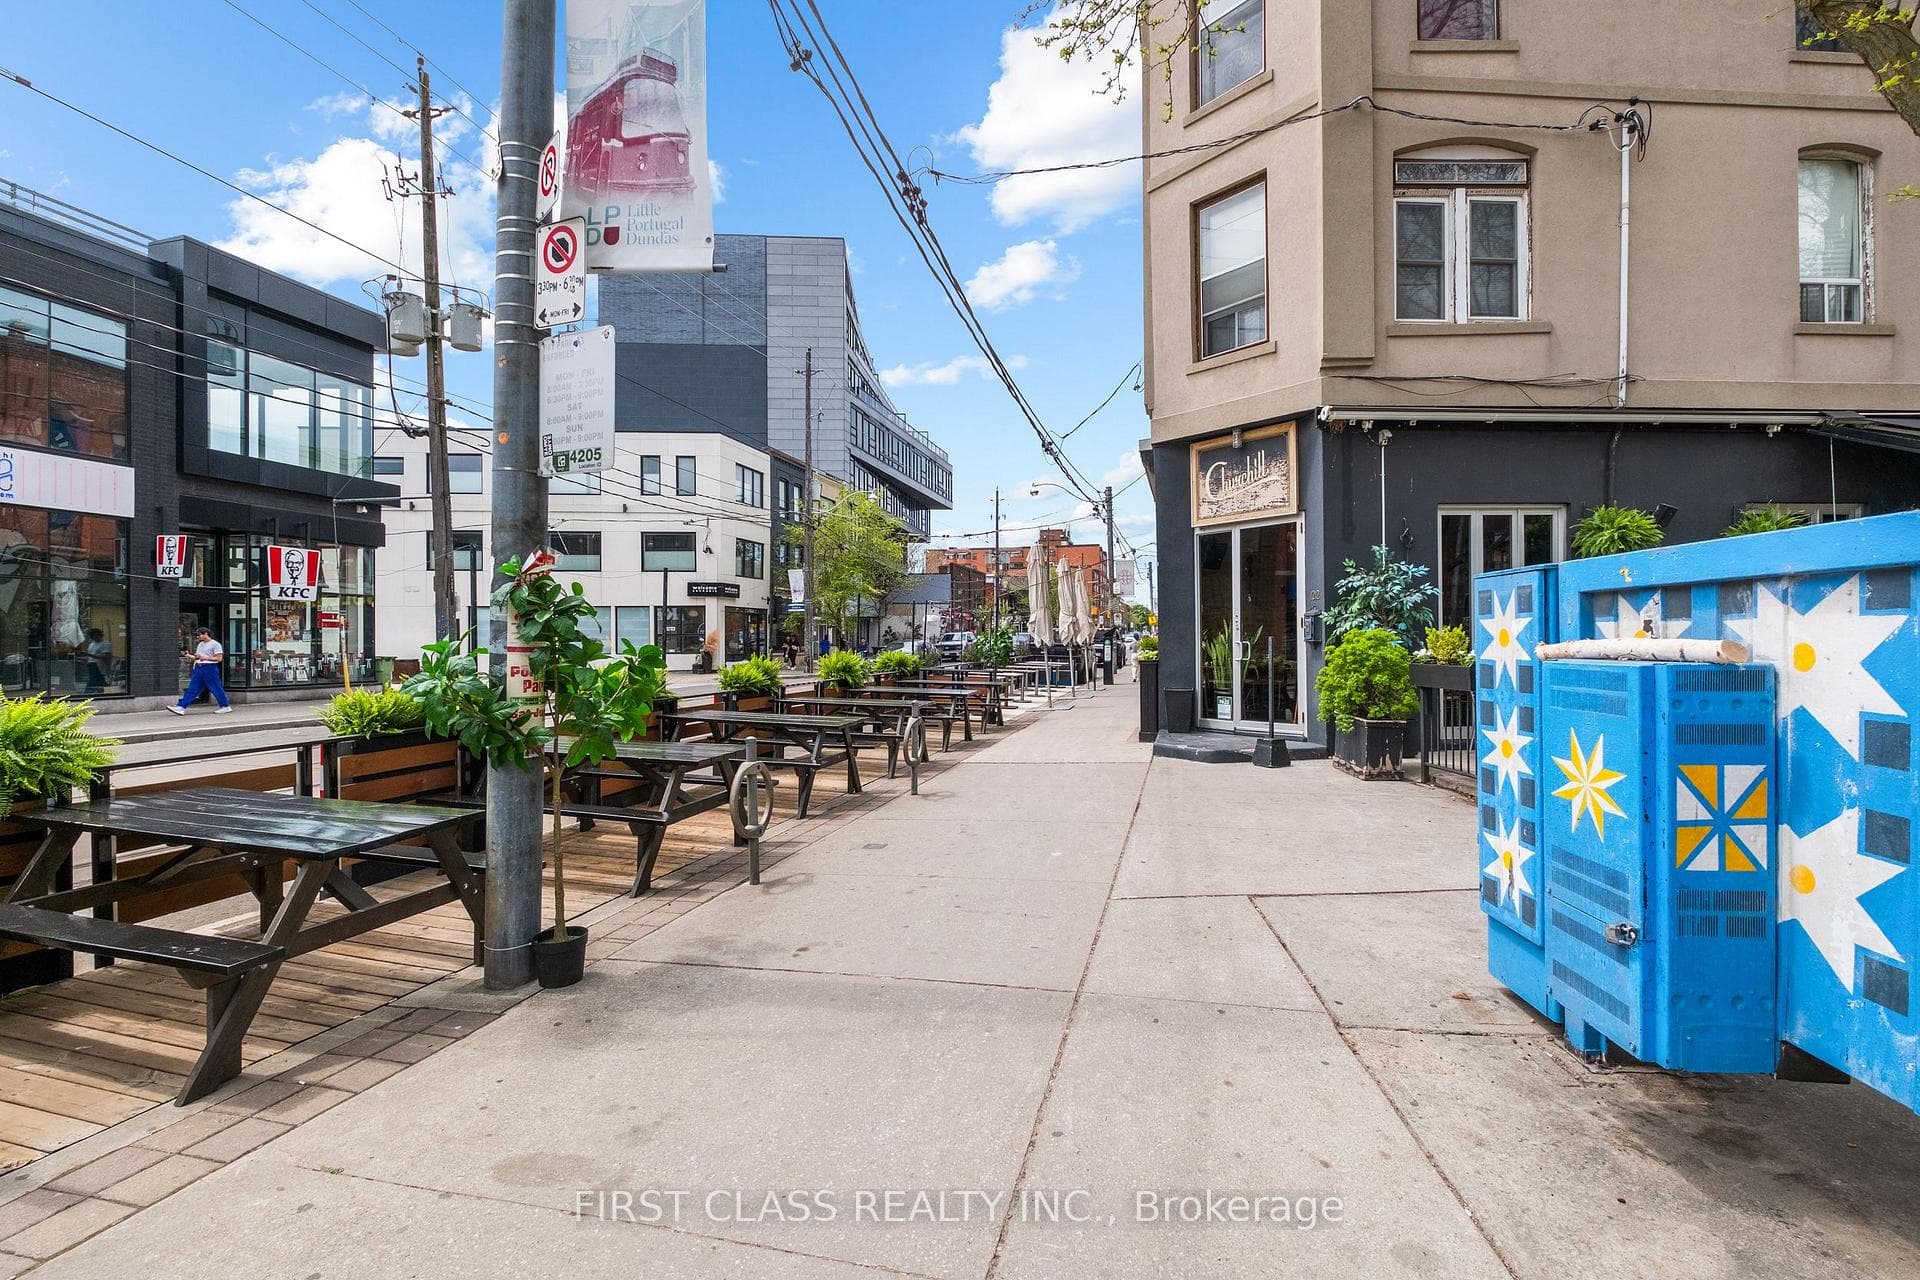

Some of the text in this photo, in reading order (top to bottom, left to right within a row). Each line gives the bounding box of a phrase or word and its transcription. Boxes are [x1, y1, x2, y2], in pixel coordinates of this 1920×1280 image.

[628, 203, 661, 217] Little
[627, 216, 684, 234] Portugal
[626, 231, 679, 245] Dundas
[567, 402, 583, 412] SAT
[566, 424, 583, 433] SUN
[570, 448, 602, 463] 4205
[1205, 449, 1270, 500] Churchill
[161, 566, 179, 576] KFC
[278, 587, 310, 599] KFC
